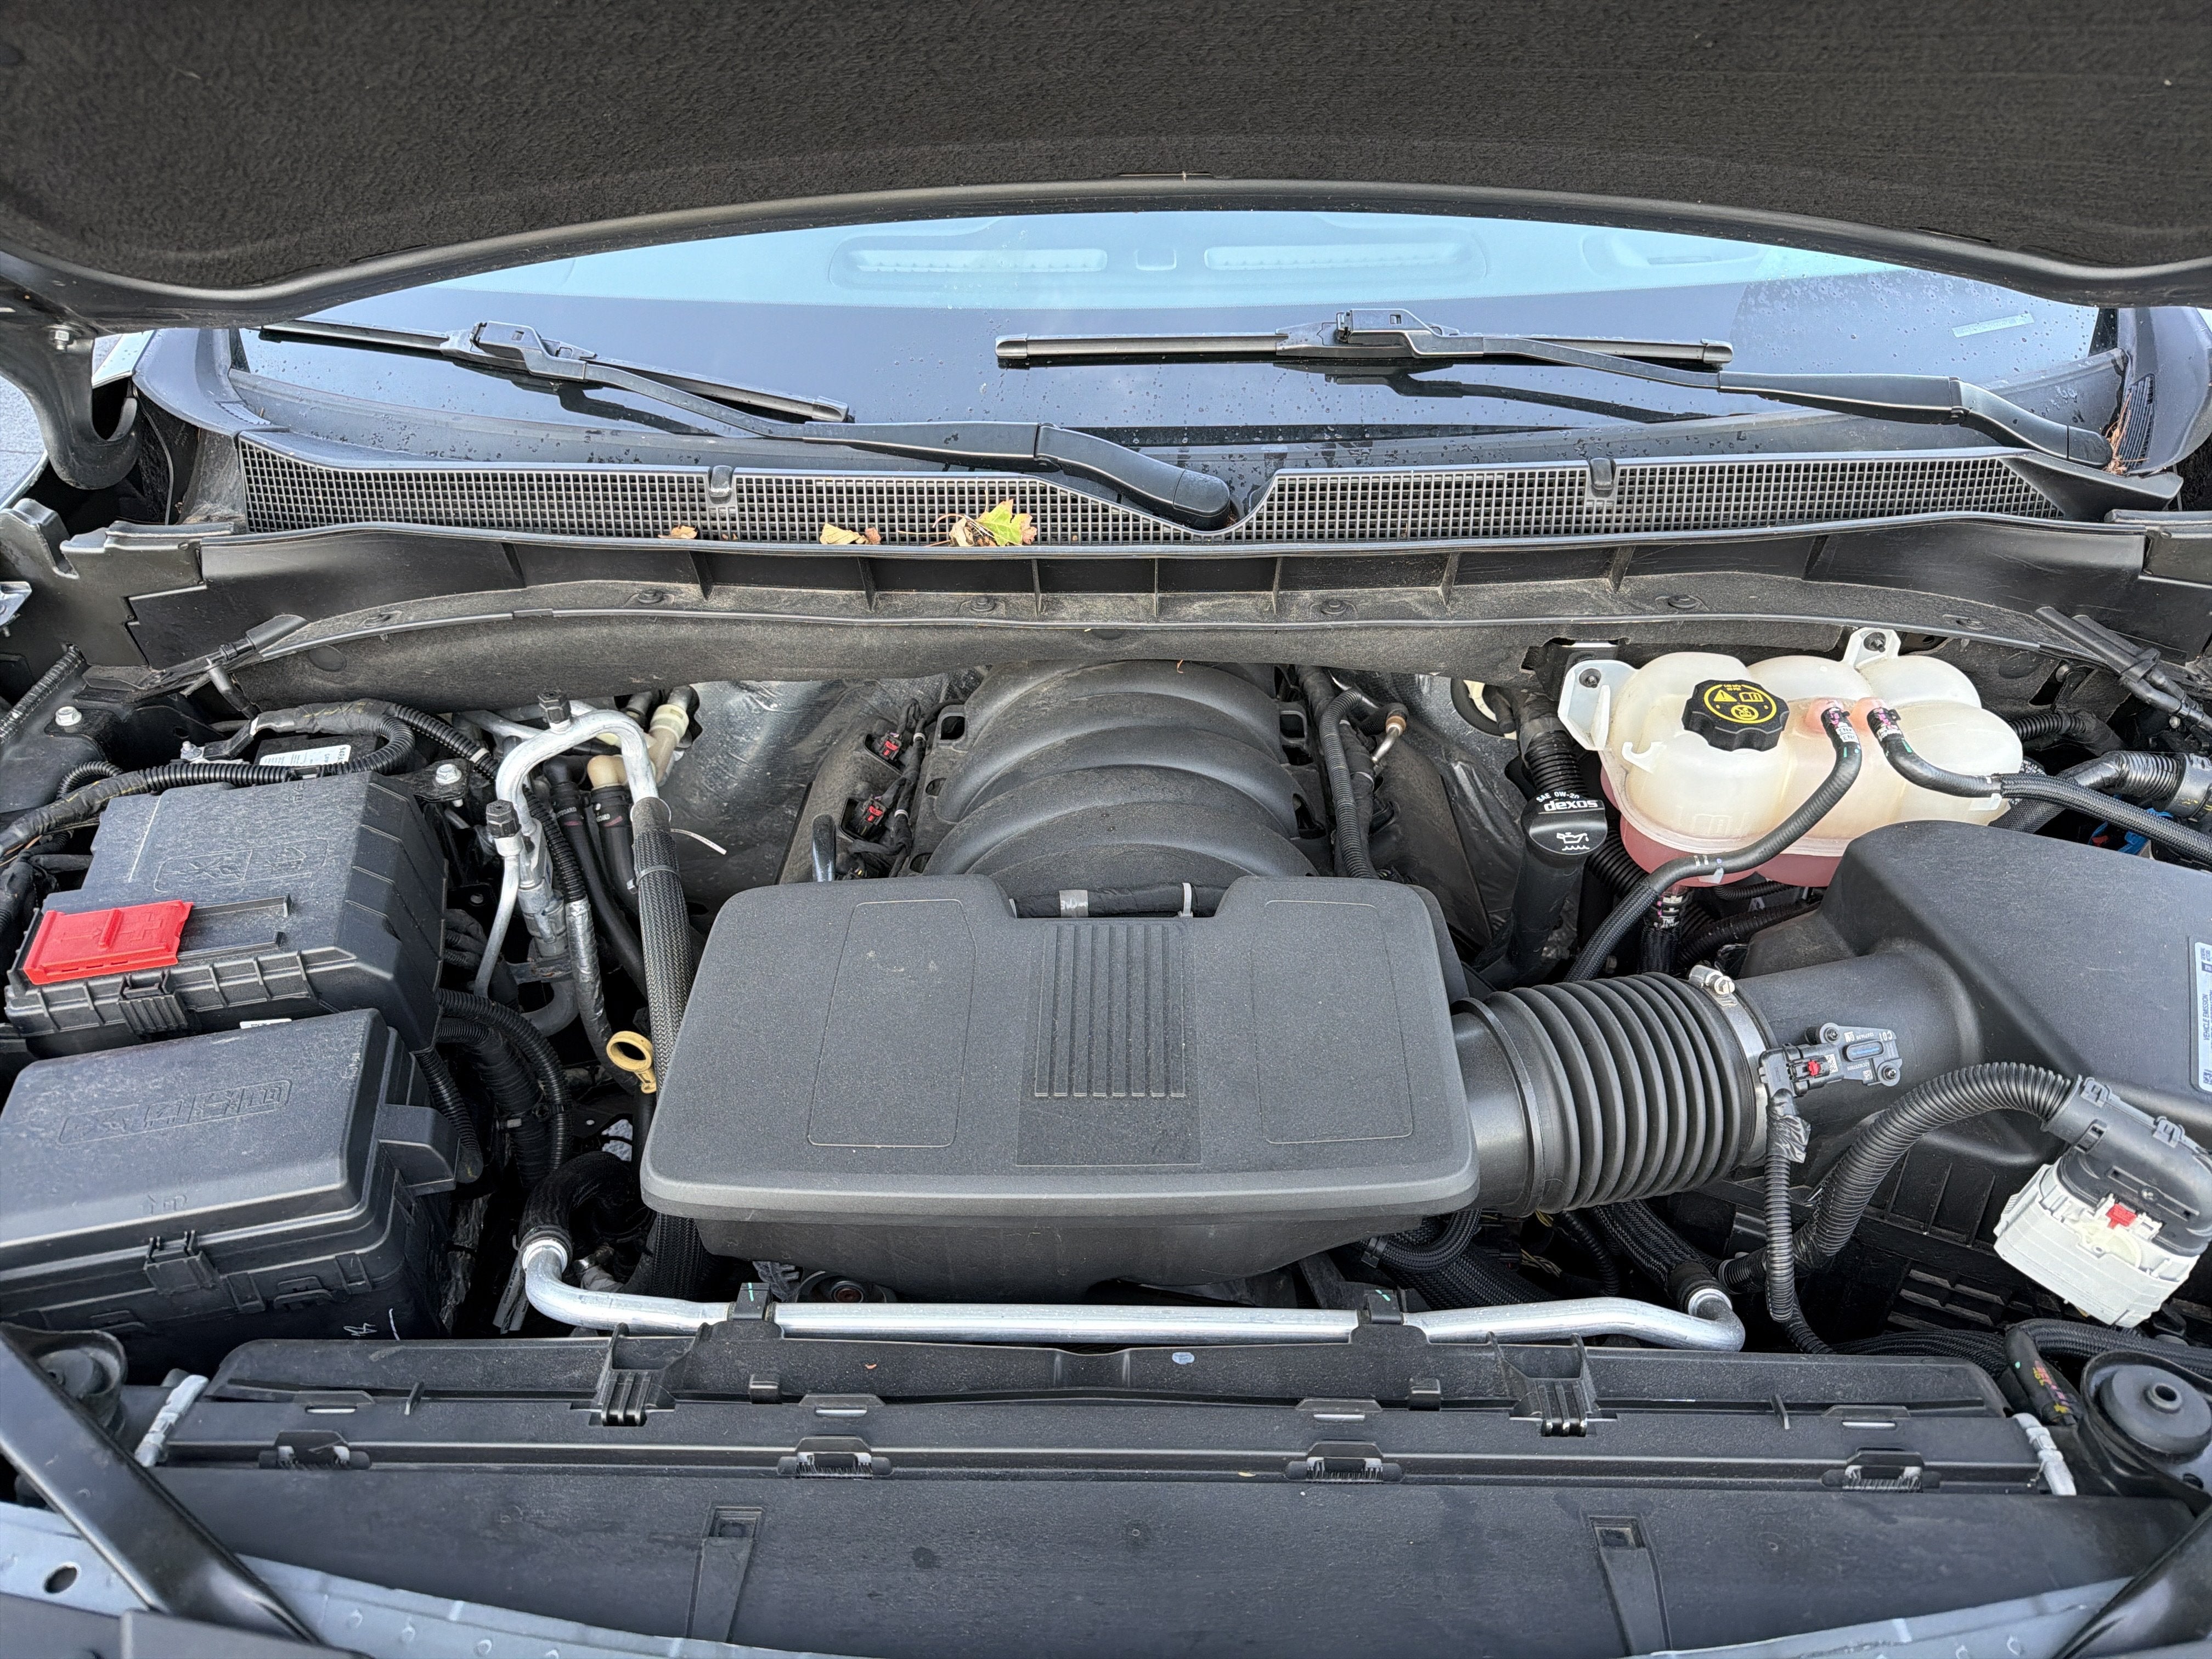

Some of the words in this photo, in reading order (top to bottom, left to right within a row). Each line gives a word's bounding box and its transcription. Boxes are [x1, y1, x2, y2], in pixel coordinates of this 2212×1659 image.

[1536, 793, 1552, 803] SAE
[1544, 800, 1599, 811] dexos
[2202, 993, 2210, 1018] EMISSION
[1844, 1031, 1855, 1042] GM
